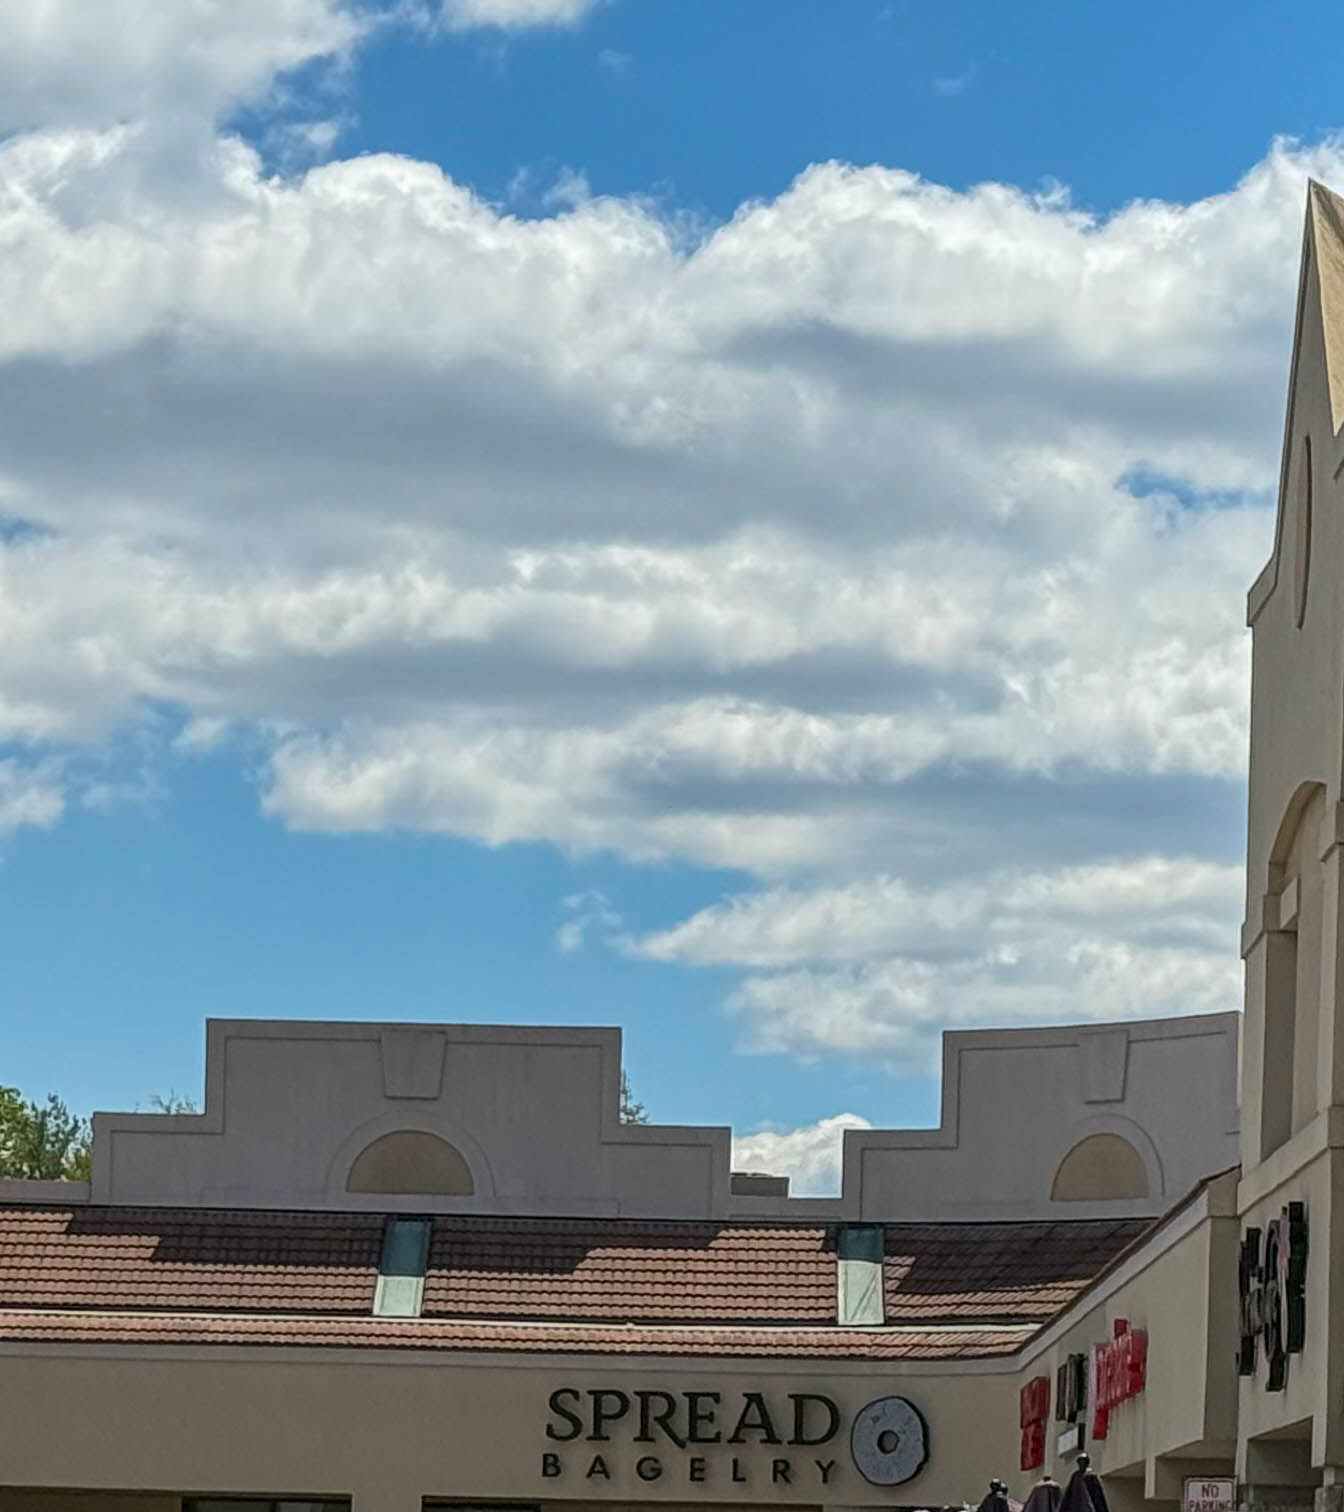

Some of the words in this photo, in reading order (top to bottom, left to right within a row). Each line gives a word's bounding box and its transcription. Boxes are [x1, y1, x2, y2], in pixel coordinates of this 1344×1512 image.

[545, 1388, 841, 1448] SPREAD
[542, 1453, 839, 1484] BAGELRY
[1201, 1484, 1219, 1498] NO
